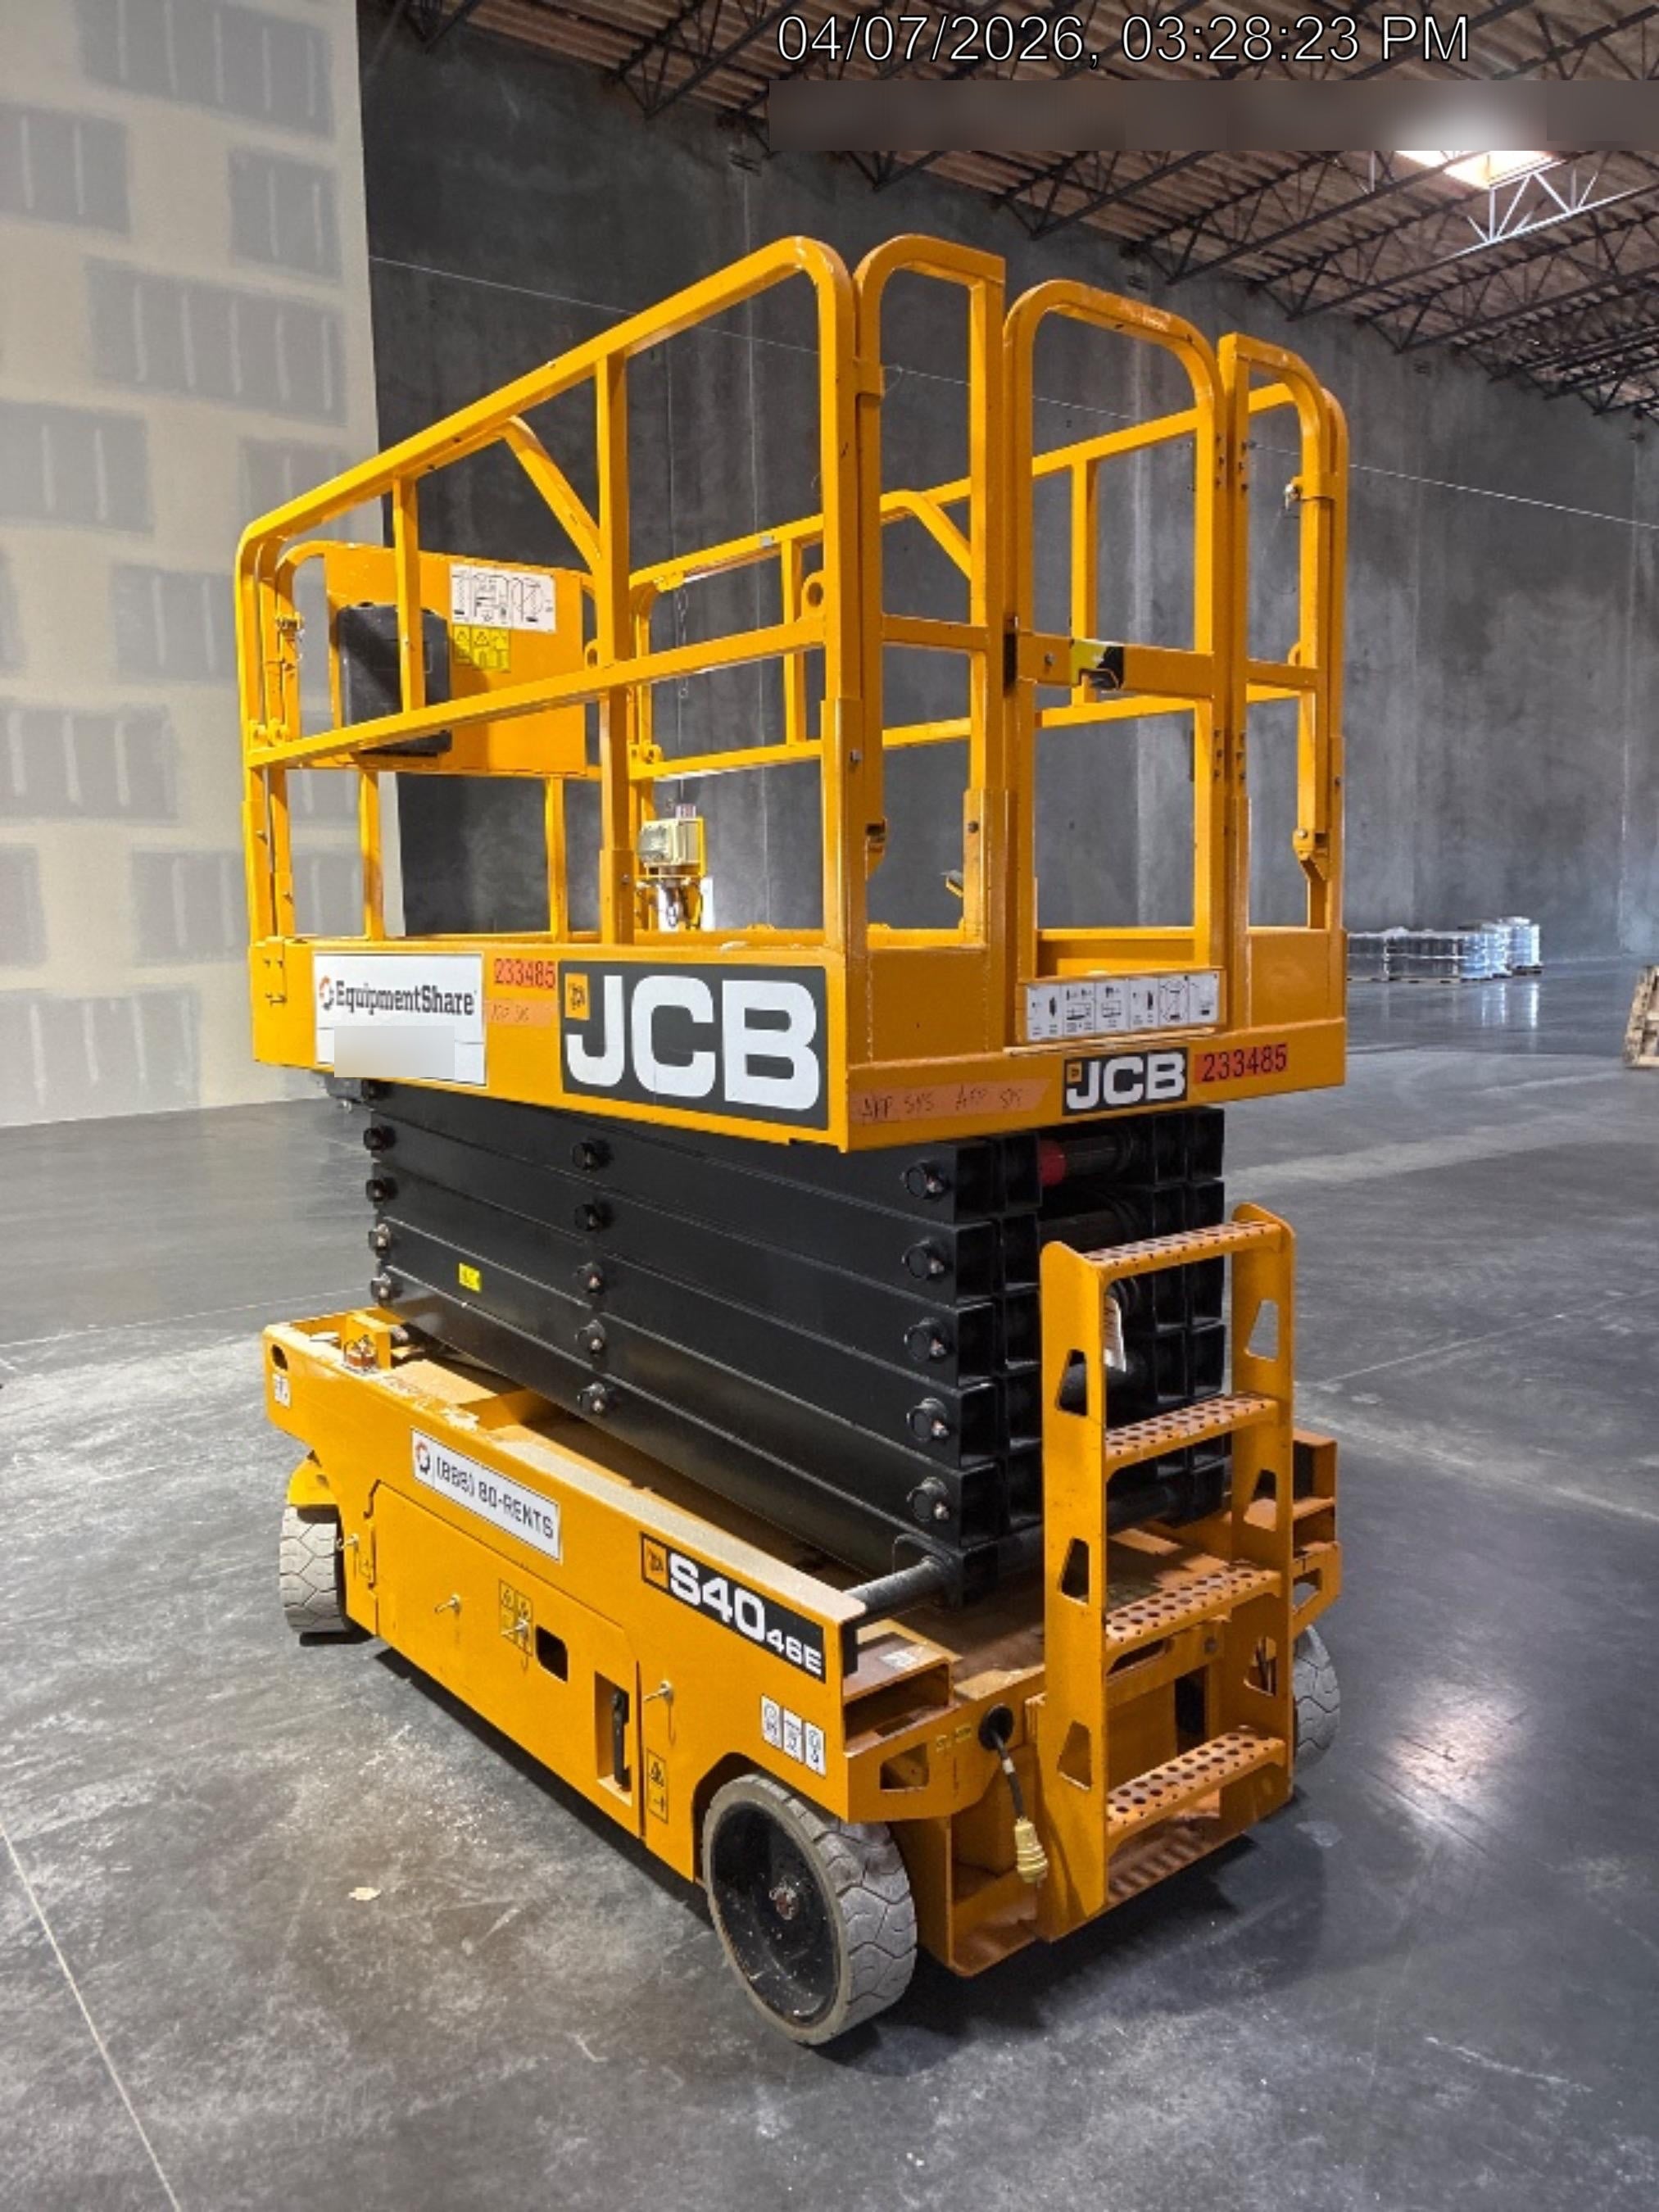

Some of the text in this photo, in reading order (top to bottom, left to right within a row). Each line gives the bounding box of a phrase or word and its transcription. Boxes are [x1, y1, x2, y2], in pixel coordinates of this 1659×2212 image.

[335, 980, 475, 1016] EquipmentShare
[493, 958, 556, 990] 233485
[564, 973, 820, 1111] JCB
[1201, 1043, 1288, 1082] 233485
[1066, 1052, 1186, 1109] JCB
[436, 1456, 555, 1539] (888) 80-RENTS
